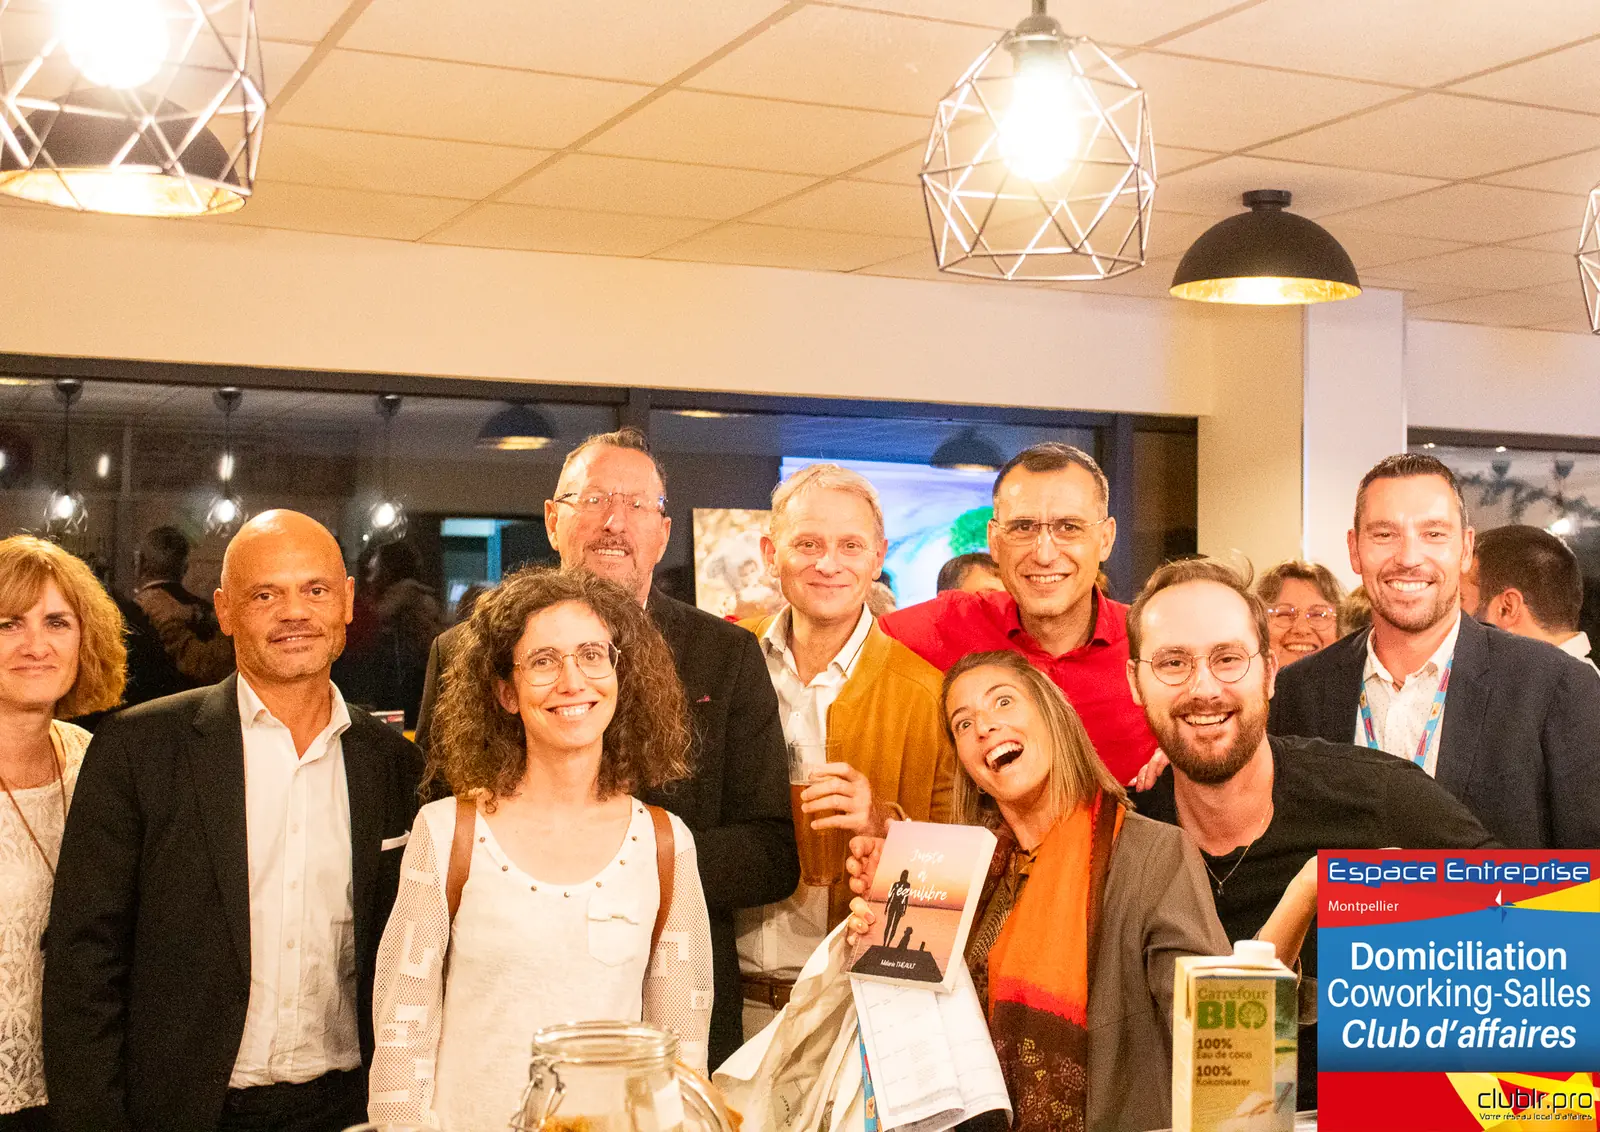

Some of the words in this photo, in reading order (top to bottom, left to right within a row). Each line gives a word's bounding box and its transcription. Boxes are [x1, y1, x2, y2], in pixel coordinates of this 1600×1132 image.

[910, 849, 944, 864] Juste
[1197, 986, 1268, 1000] Carrefour
[1197, 1000, 1268, 1030] BIO
[1196, 1038, 1233, 1050] 100%
[1196, 1050, 1213, 1059] Eau
[1215, 1050, 1227, 1059] de
[1229, 1051, 1253, 1060] coco
[1196, 1065, 1232, 1077] 100%
